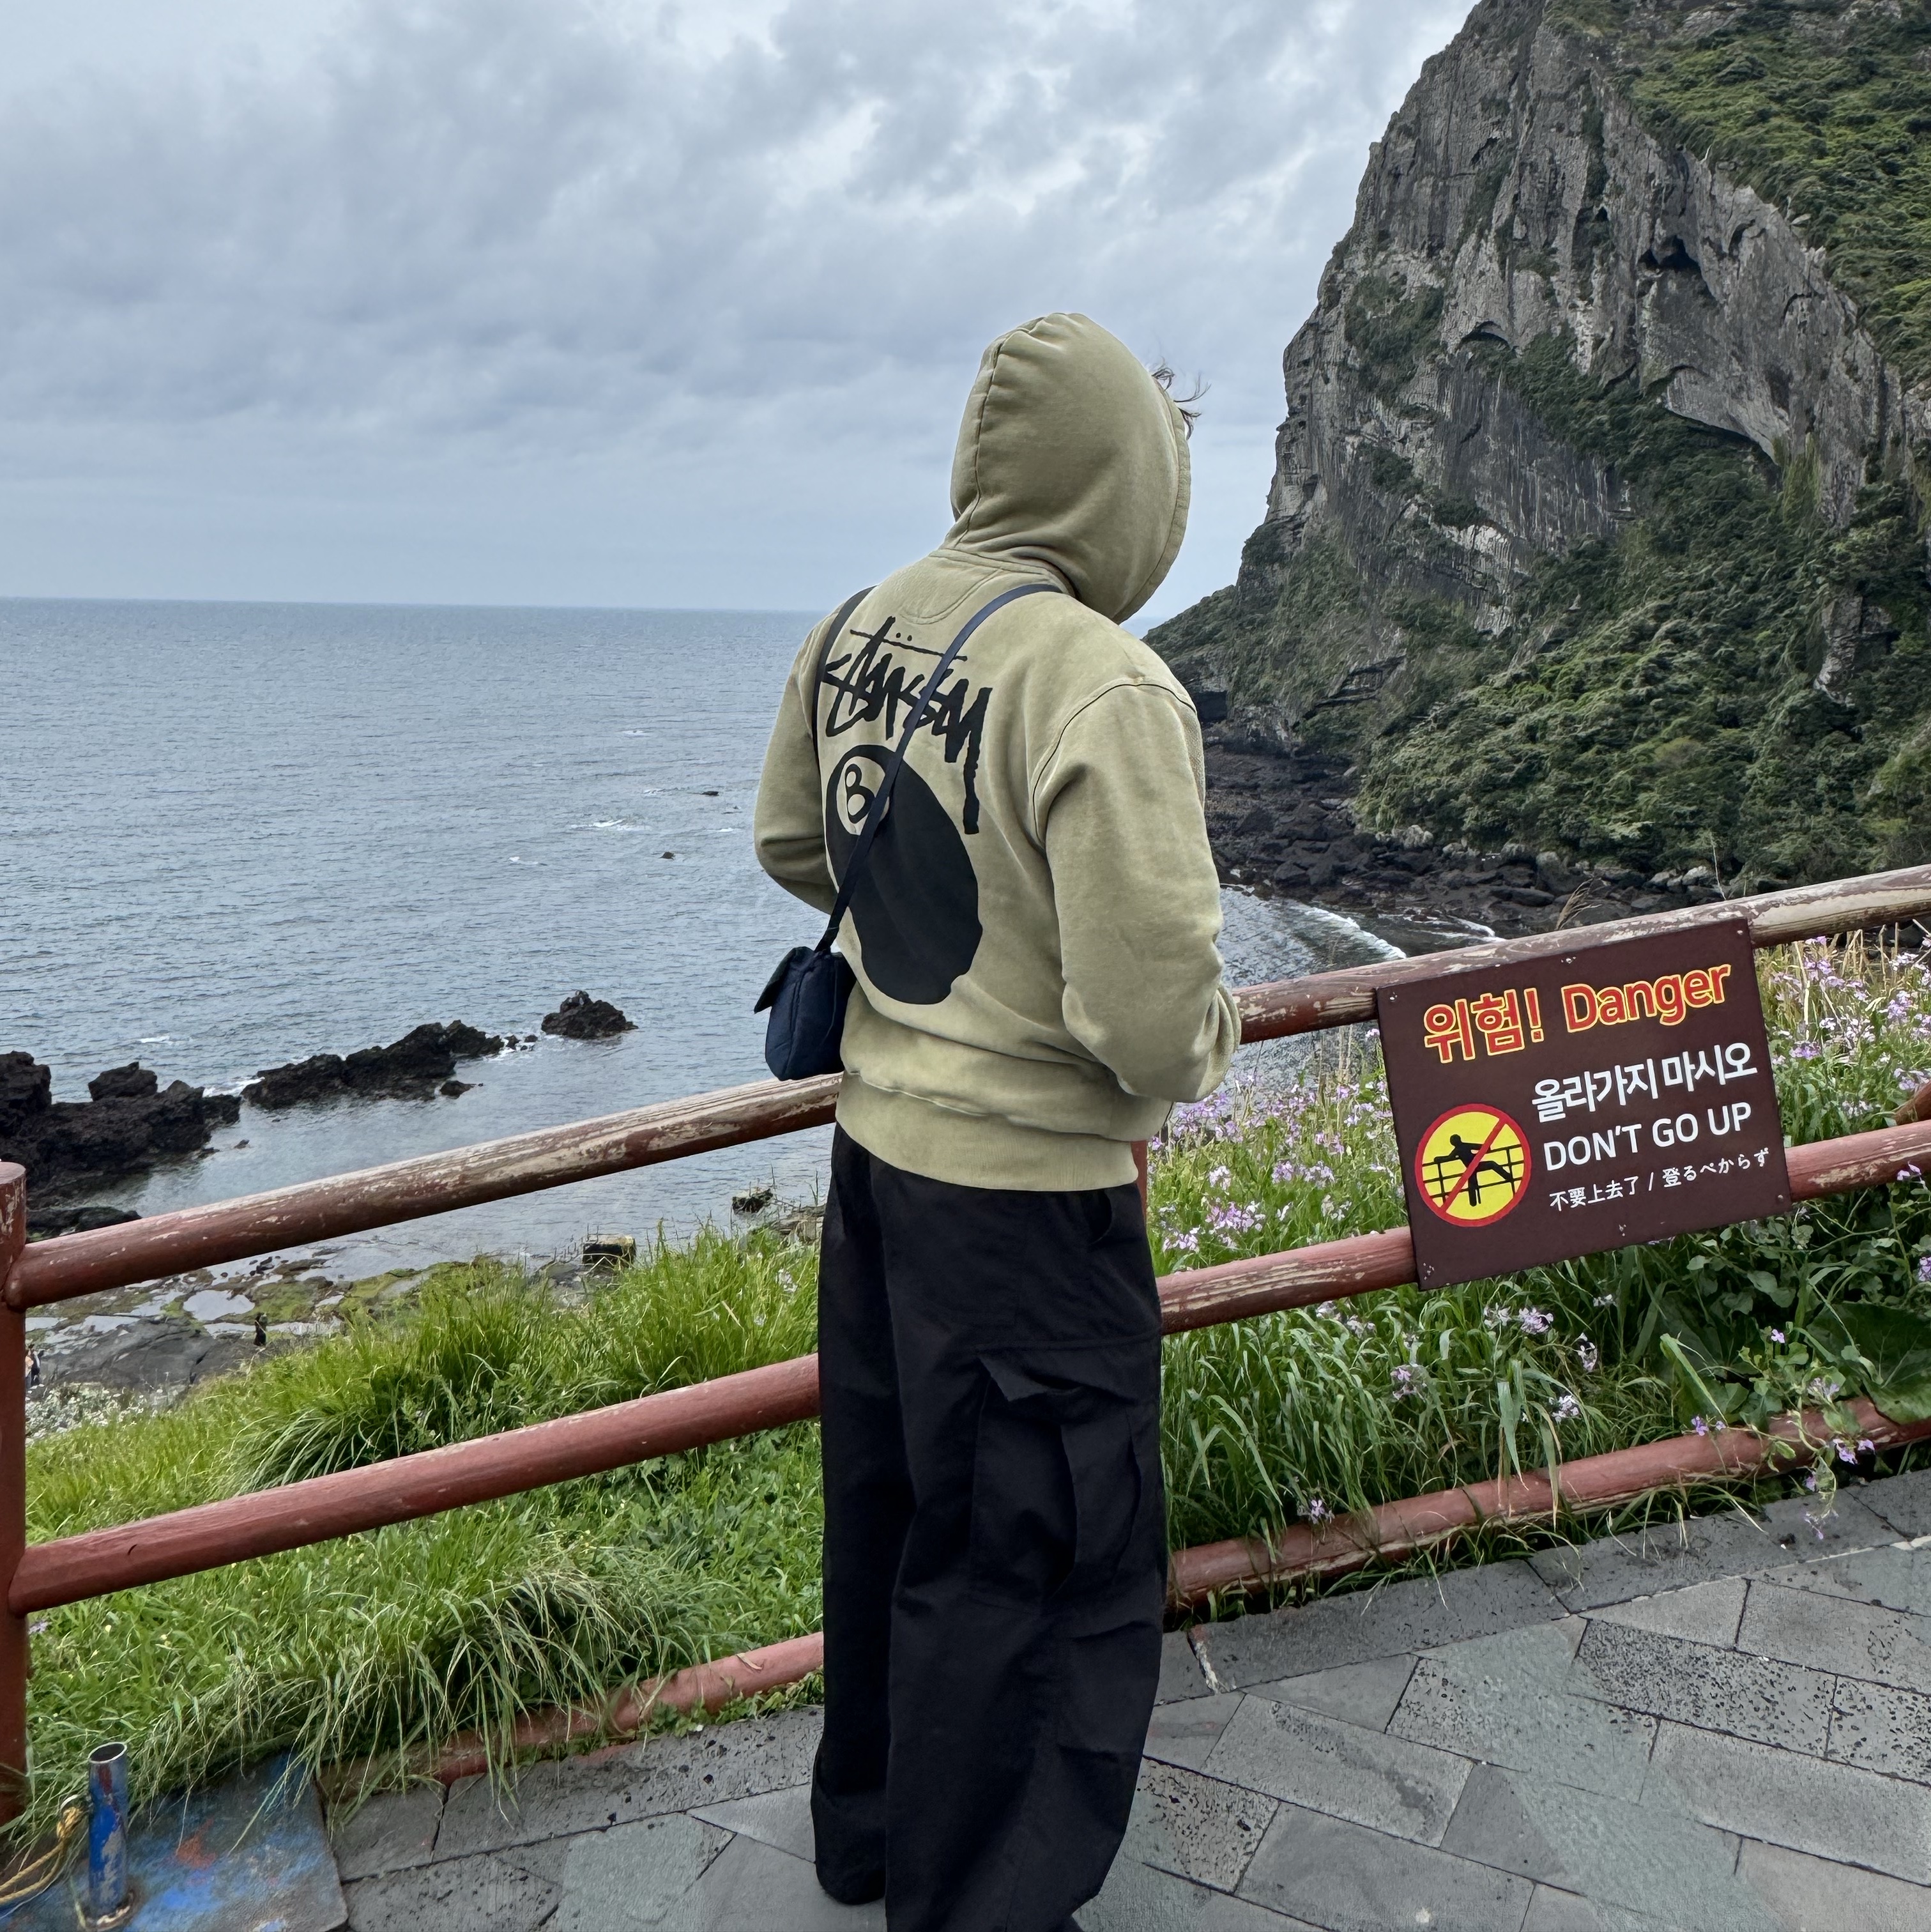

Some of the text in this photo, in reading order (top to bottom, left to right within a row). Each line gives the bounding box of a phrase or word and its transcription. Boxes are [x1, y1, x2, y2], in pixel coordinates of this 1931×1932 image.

[1424, 964, 1732, 1064] 위험! Danger
[1531, 1043, 1758, 1123] 올라가지 마시오
[1544, 1102, 1752, 1171] DON'T GO UP
[1549, 1176, 1640, 1212] 不要上去了
